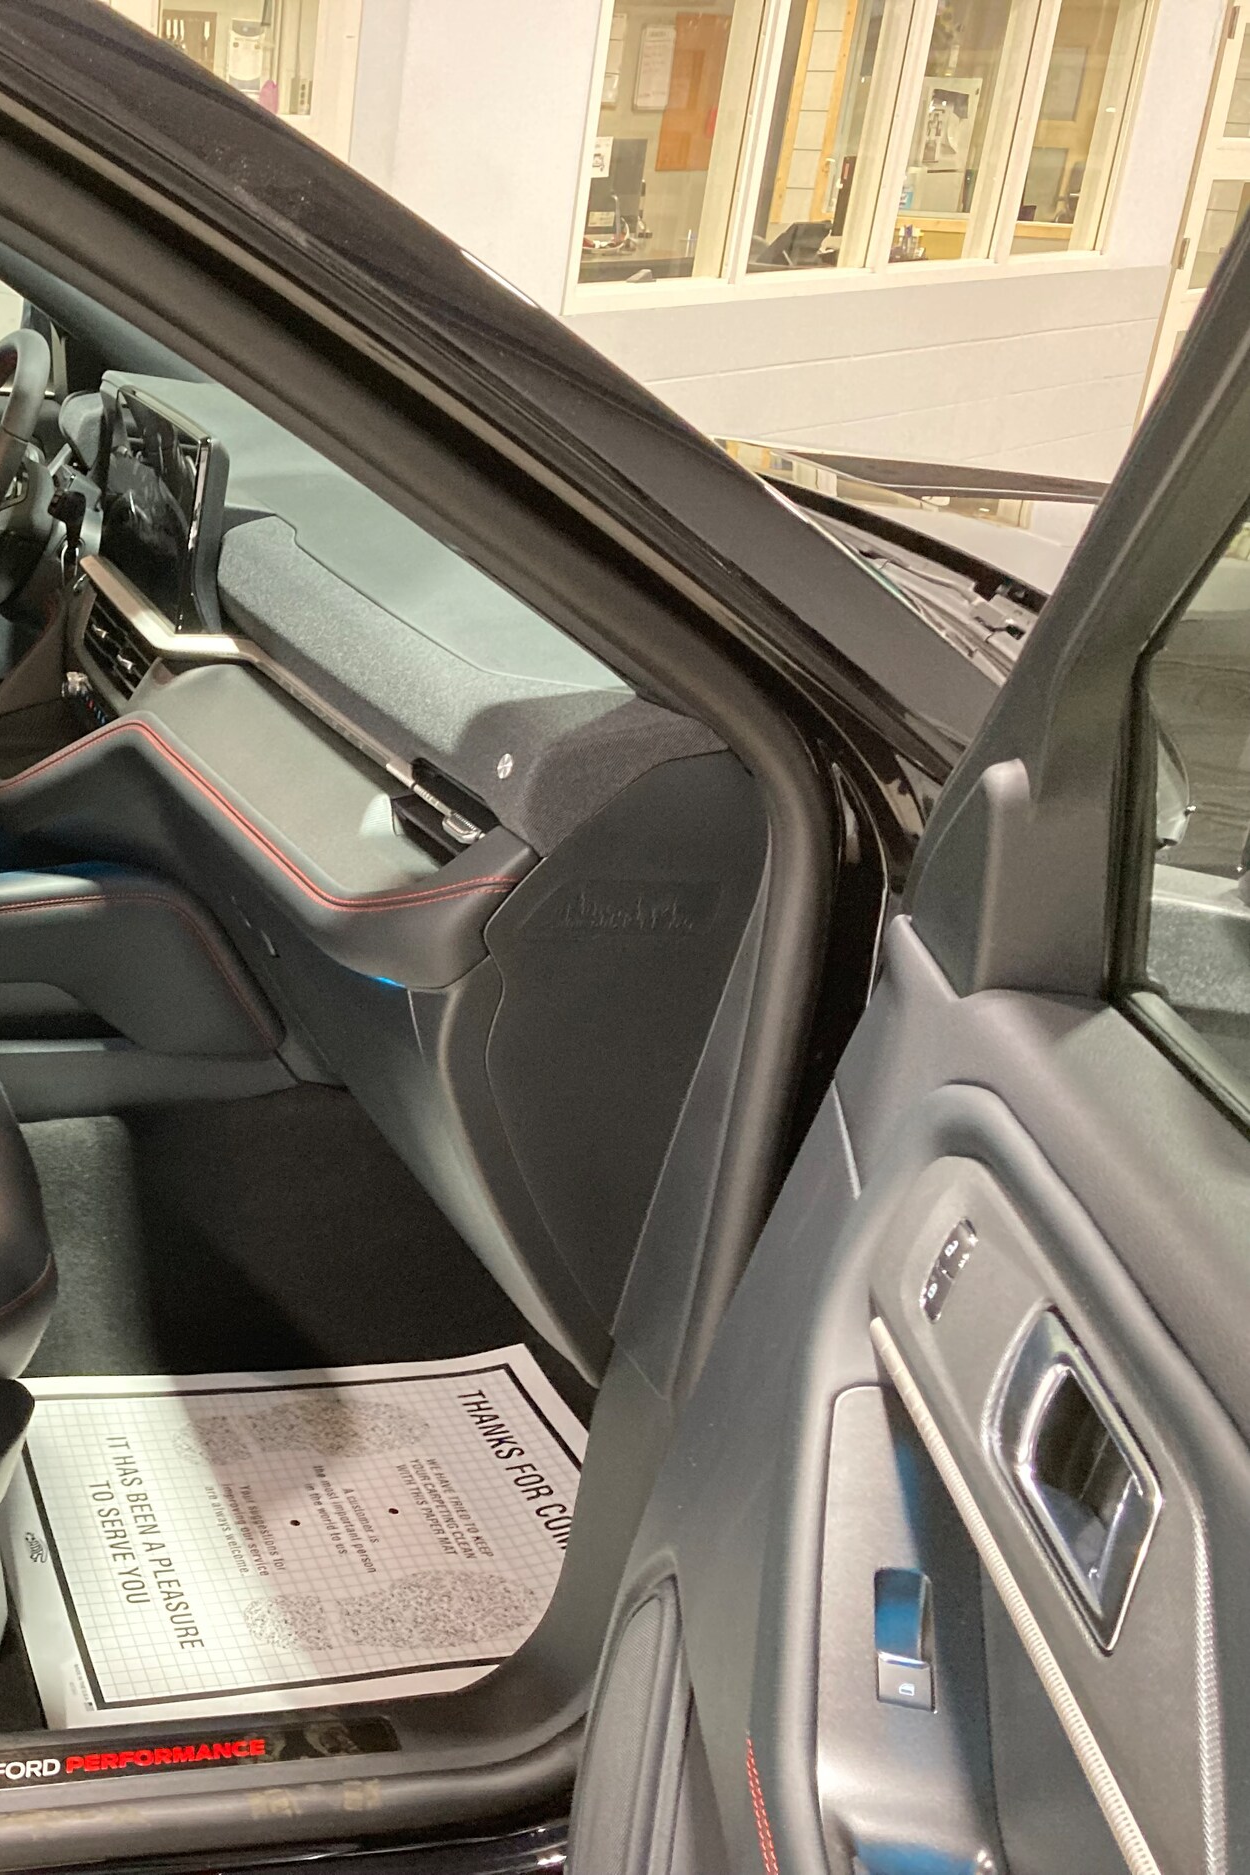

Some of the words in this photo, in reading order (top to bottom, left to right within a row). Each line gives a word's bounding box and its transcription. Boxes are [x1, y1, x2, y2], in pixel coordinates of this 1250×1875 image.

[106, 1437, 130, 1450] IT
[458, 1389, 524, 1459] THANKS
[505, 1463, 553, 1501] FOR
[113, 1455, 143, 1486] HAS
[426, 1458, 441, 1471] WE
[89, 1480, 114, 1501] TO
[304, 1482, 315, 1492] in
[436, 1472, 454, 1493] HAVE
[126, 1492, 161, 1535] BEEN
[221, 1483, 246, 1526] improving
[309, 1492, 323, 1506] the
[396, 1464, 415, 1487] WITH
[410, 1487, 428, 1506] THIS
[421, 1506, 445, 1535] PAPER
[438, 1536, 458, 1555] MAT
[410, 1459, 429, 1481] YOUR
[423, 1481, 458, 1532] CARPETING
[452, 1531, 477, 1559] CLEAN
[450, 1494, 471, 1521] TRIED
[97, 1508, 136, 1562] SERVE
[205, 1486, 218, 1500] are
[212, 1502, 231, 1533] always
[225, 1533, 249, 1576] welcome.
[240, 1485, 255, 1505] Your
[249, 1505, 279, 1556] suggestions
[273, 1558, 286, 1571] for
[241, 1527, 254, 1541] our
[313, 1465, 325, 1478] the
[320, 1479, 338, 1504] most
[331, 1500, 361, 1542] important
[352, 1542, 377, 1573] person
[317, 1505, 337, 1535] world
[348, 1496, 375, 1533] customer
[368, 1534, 380, 1544] is
[464, 1521, 479, 1534] TO
[142, 1542, 166, 1552] A
[330, 1531, 341, 1542] to
[471, 1534, 494, 1557] KEEP
[247, 1542, 269, 1576] service
[118, 1567, 151, 1604] YOU
[148, 1557, 204, 1649] PLEASURE
[65, 1739, 266, 1774] PERFORMANCE
